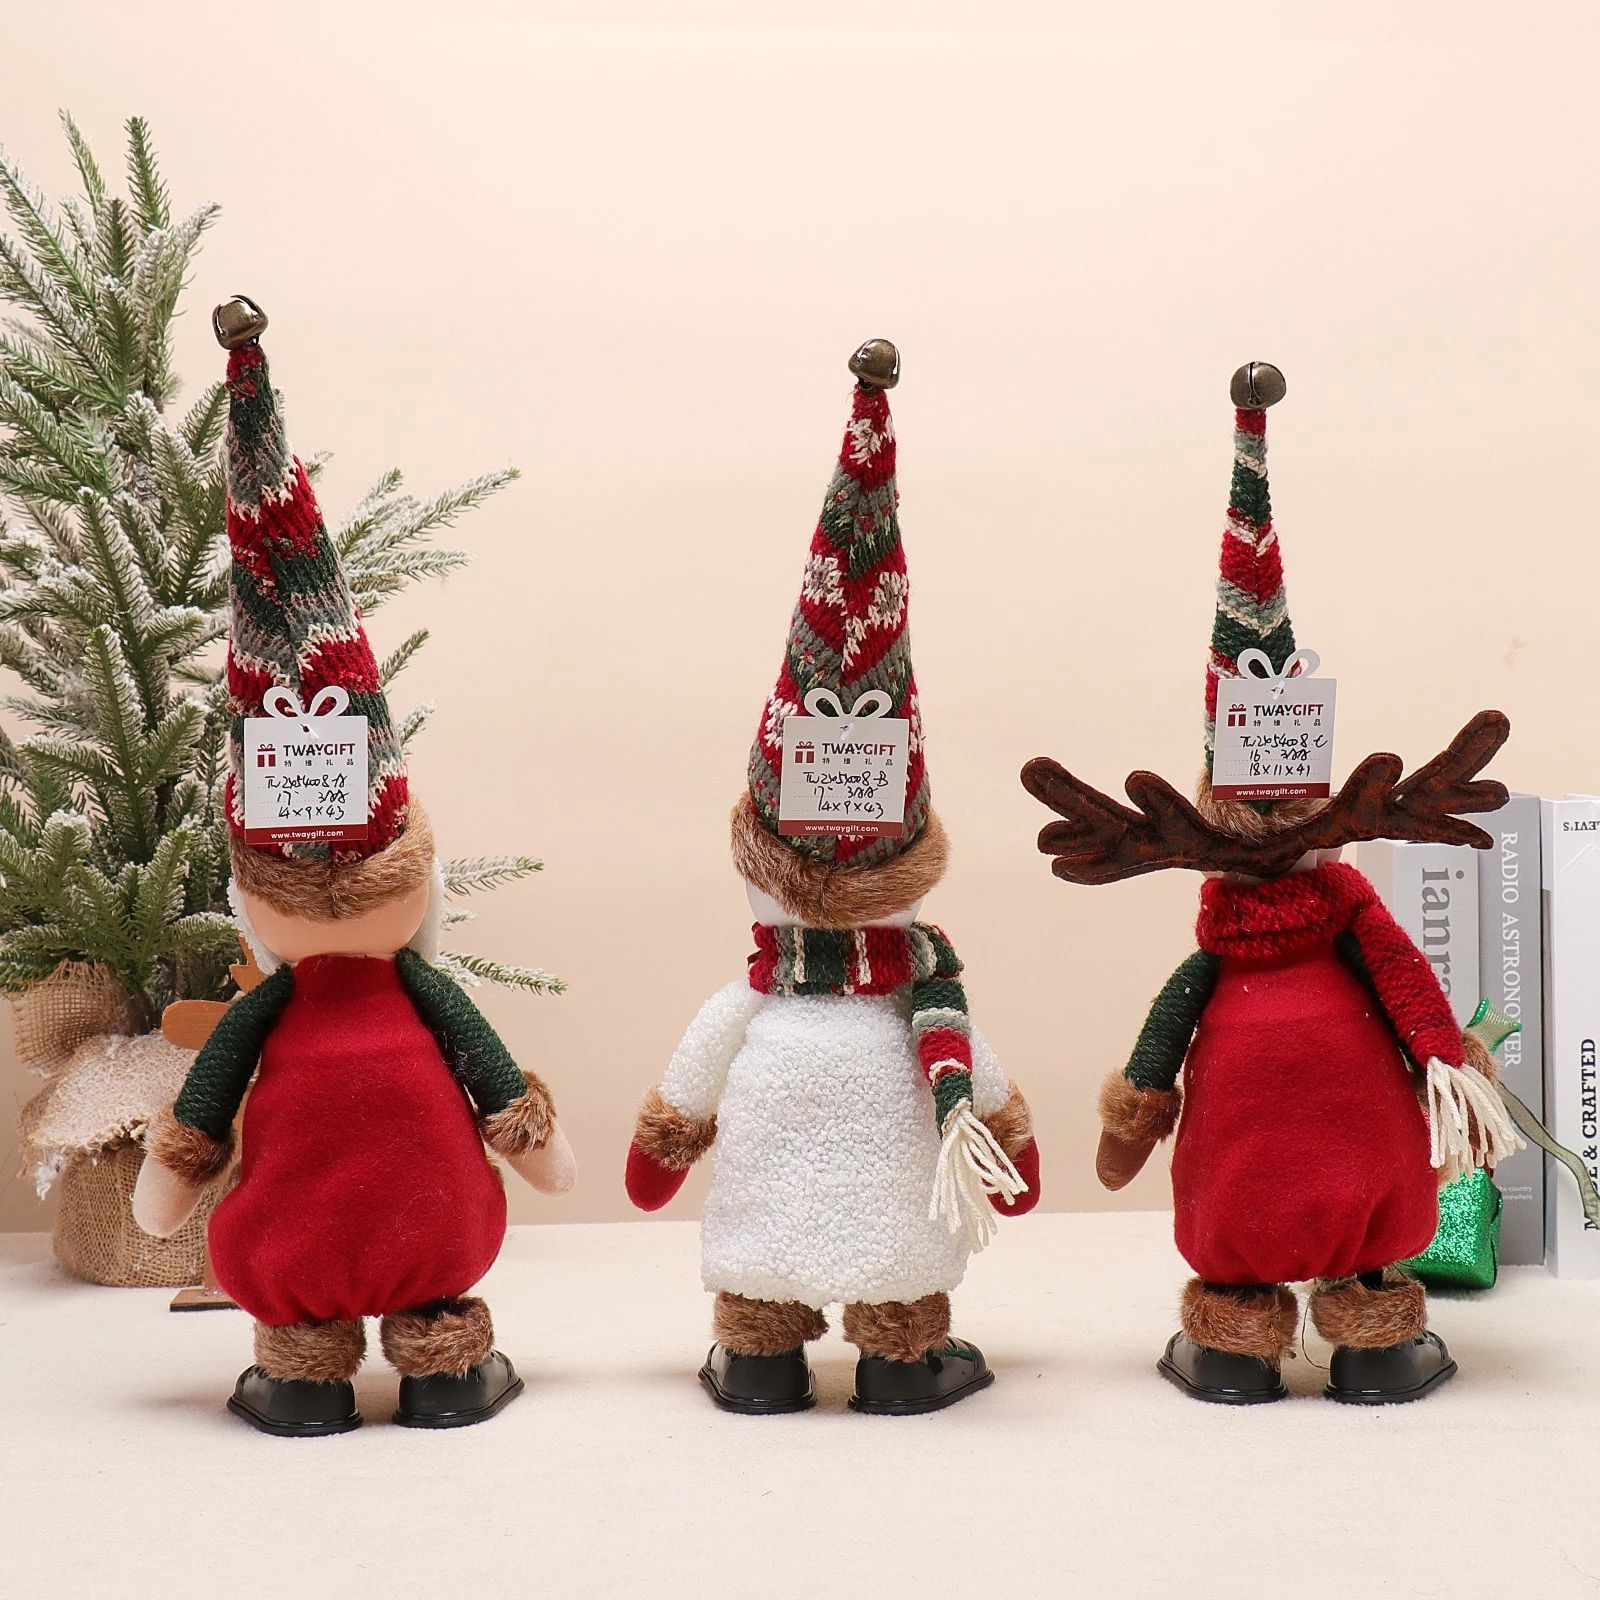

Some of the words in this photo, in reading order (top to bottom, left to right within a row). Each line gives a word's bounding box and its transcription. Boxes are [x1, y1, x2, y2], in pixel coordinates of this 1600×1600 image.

[1253, 704, 1324, 717] TWAYGIFT
[282, 743, 356, 757] TWAYGIFT
[821, 742, 896, 756] TWAYGIFT
[1236, 788, 1307, 797] www.twaygift.com
[804, 824, 879, 833] www.twaygift.com
[1563, 821, 1600, 832] EVI'S
[271, 829, 344, 839] www.twaygift.com
[1501, 831, 1520, 904] RADIO
[1502, 912, 1522, 1069] ASTRONOER
[1580, 1038, 1597, 1139] CRAFTED
[1582, 1145, 1598, 1161] &
